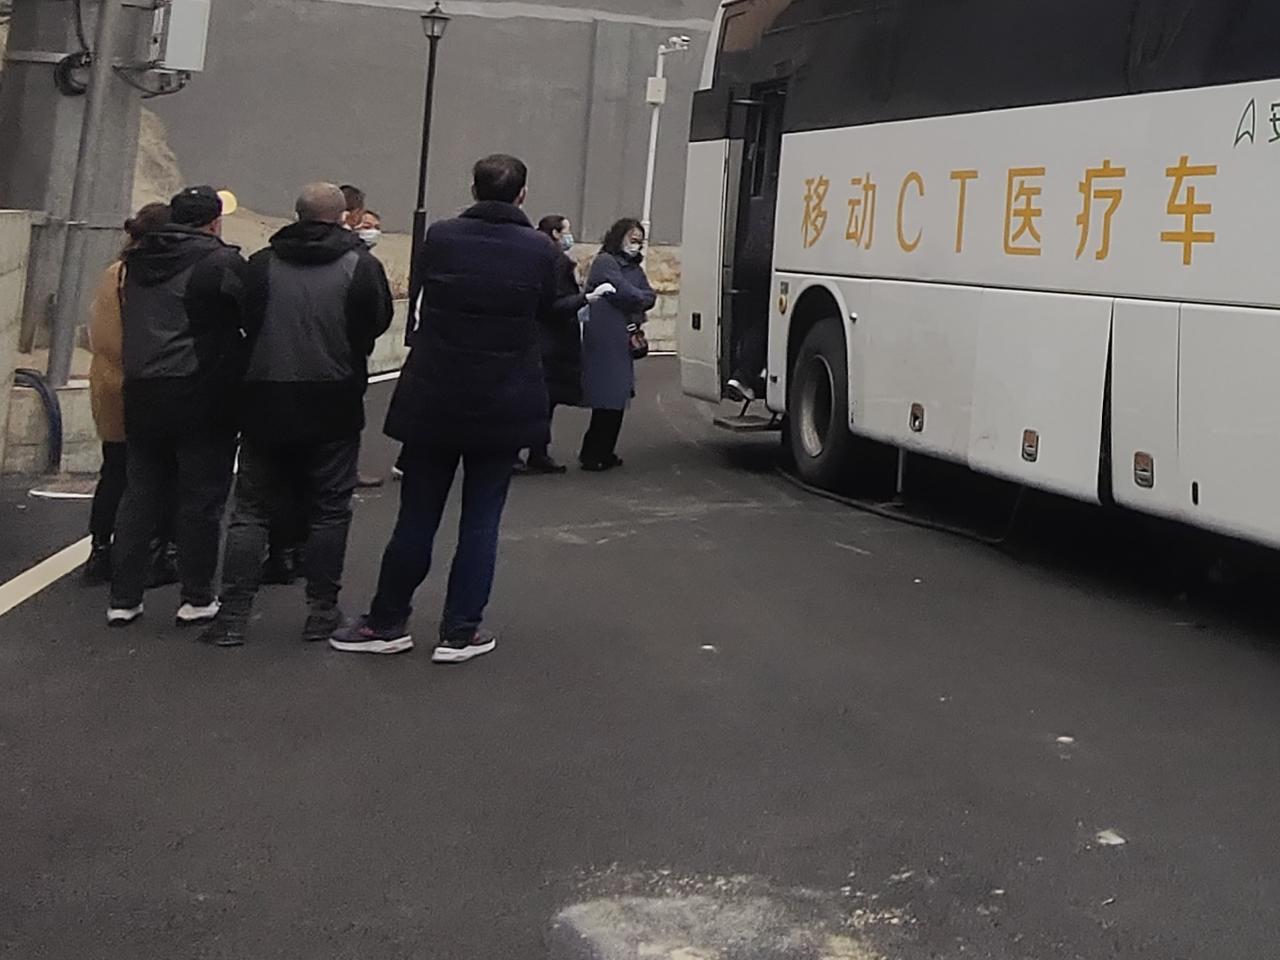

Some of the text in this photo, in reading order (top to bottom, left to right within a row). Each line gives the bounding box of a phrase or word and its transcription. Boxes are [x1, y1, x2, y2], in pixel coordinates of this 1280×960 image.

[800, 155, 1218, 266] 移动CT医疗车
